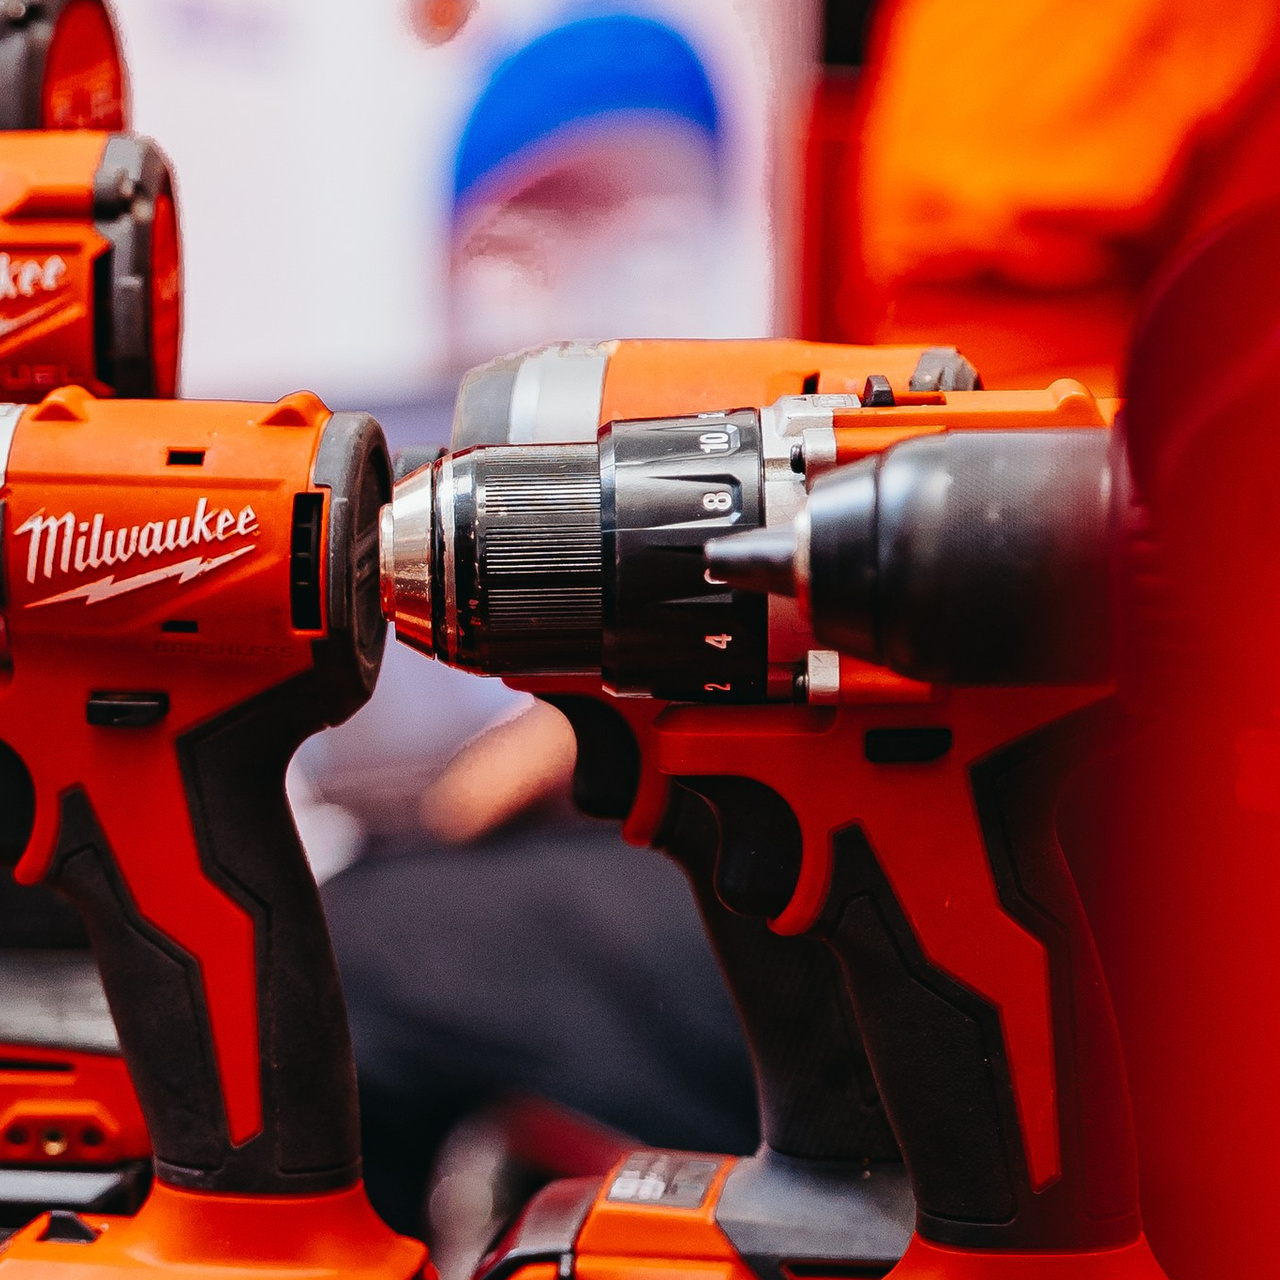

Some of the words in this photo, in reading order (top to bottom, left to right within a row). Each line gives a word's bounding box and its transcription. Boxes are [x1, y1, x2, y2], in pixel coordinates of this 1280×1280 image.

[699, 432, 730, 454] 10
[702, 492, 732, 510] 8
[13, 496, 260, 584] Milwaukee
[705, 633, 732, 649] 4
